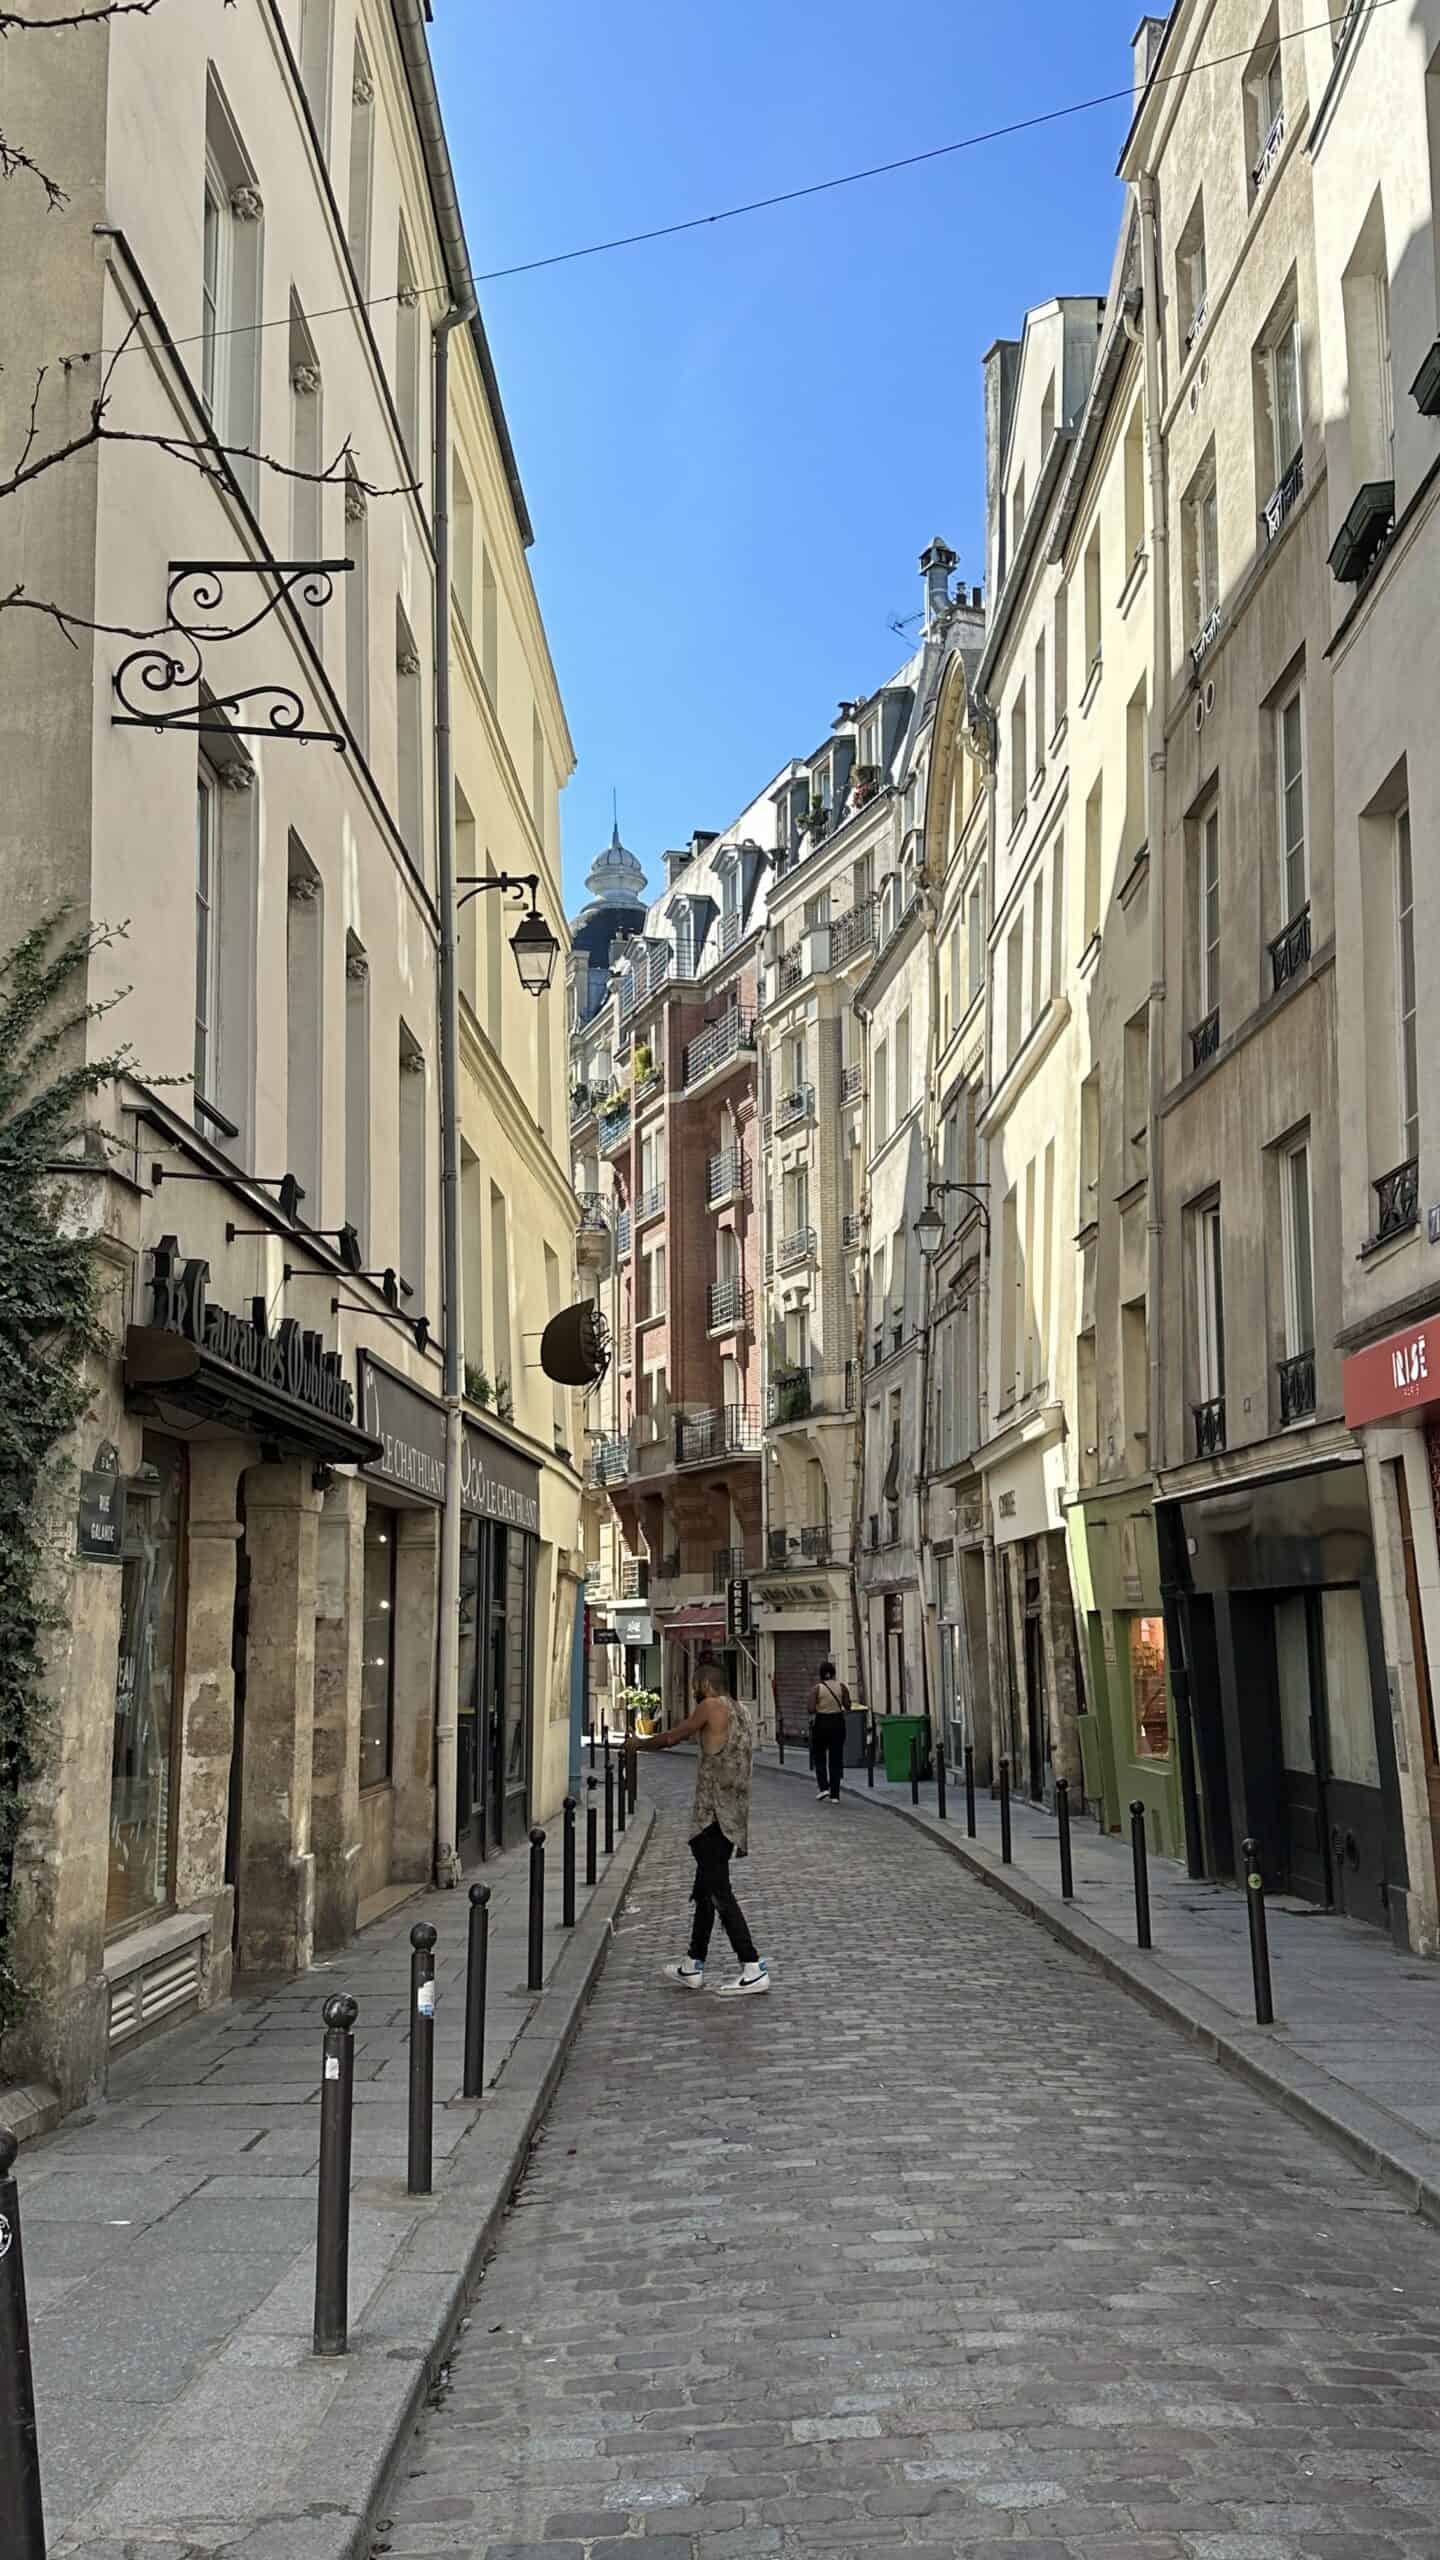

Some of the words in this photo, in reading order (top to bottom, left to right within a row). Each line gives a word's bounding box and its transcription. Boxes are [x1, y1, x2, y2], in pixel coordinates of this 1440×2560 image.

[381, 1432, 393, 1474] LE
[394, 1439, 416, 1484] CHAT
[417, 1451, 446, 1498] HUANT
[486, 1479, 497, 1514] LE
